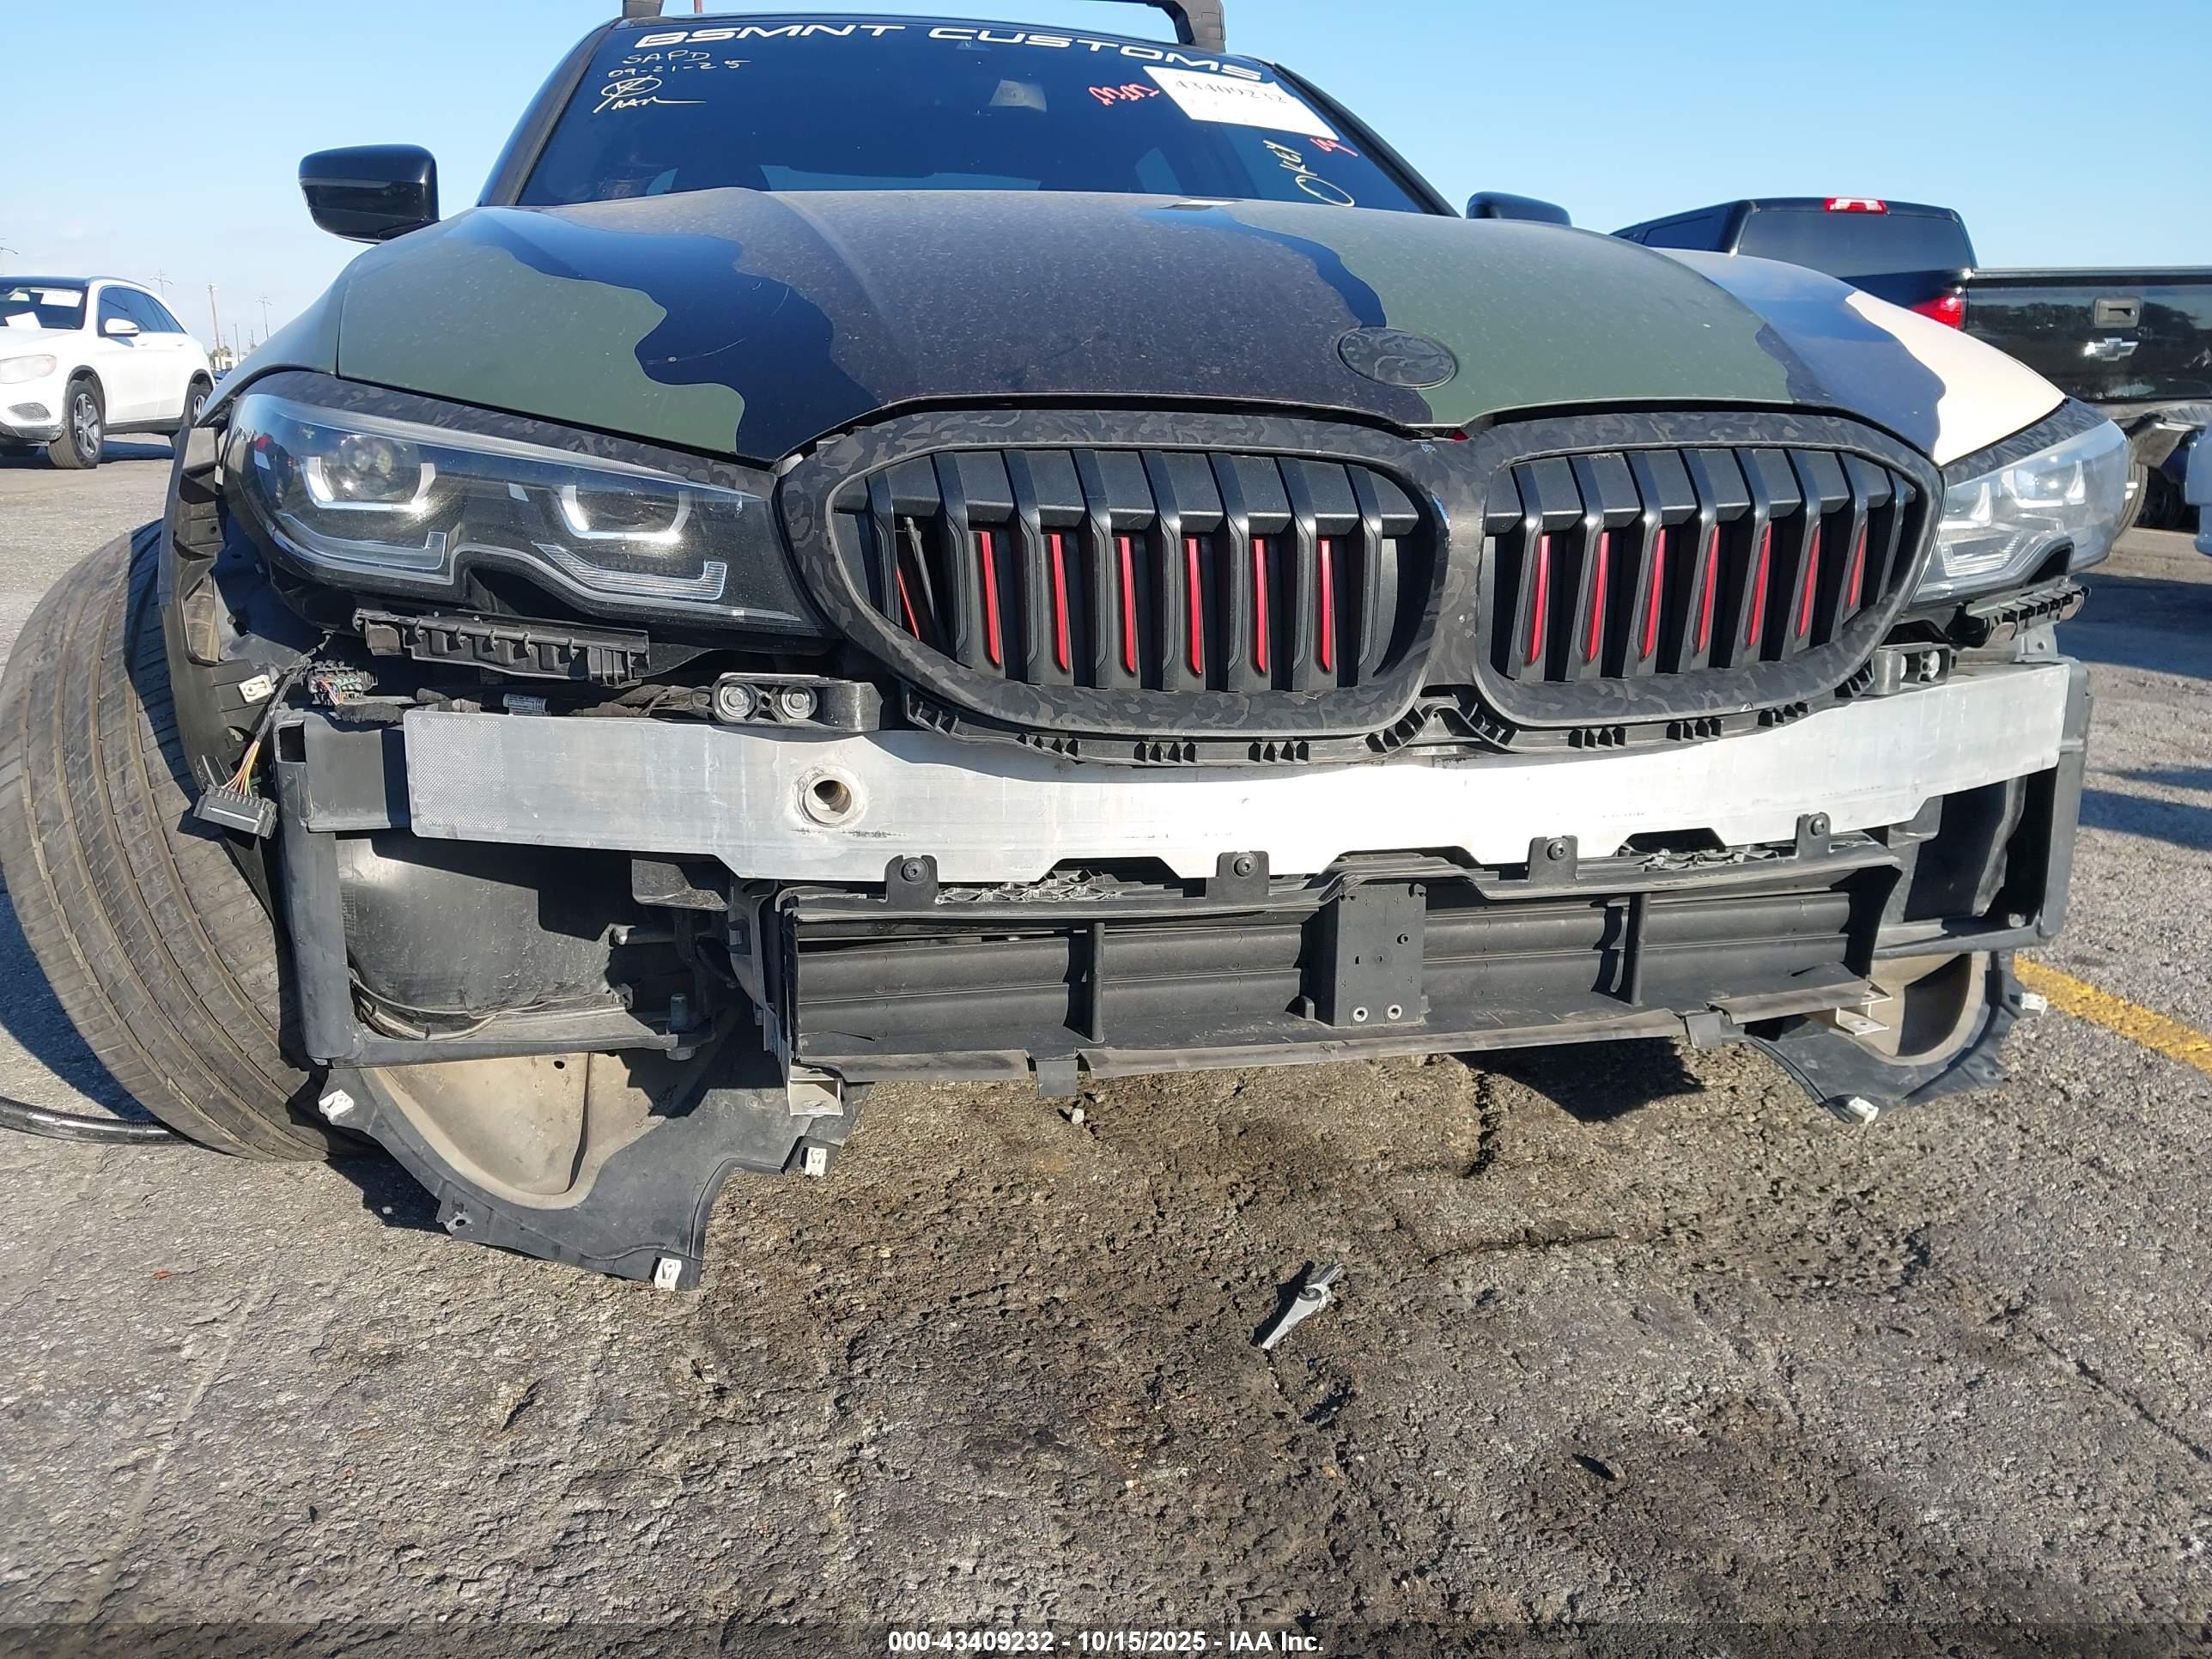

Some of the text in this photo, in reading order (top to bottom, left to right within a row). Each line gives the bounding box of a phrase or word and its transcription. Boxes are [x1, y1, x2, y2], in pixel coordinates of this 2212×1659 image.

[623, 49, 711, 64] SAPD
[635, 24, 1262, 82] BSMNT CUSTOMS
